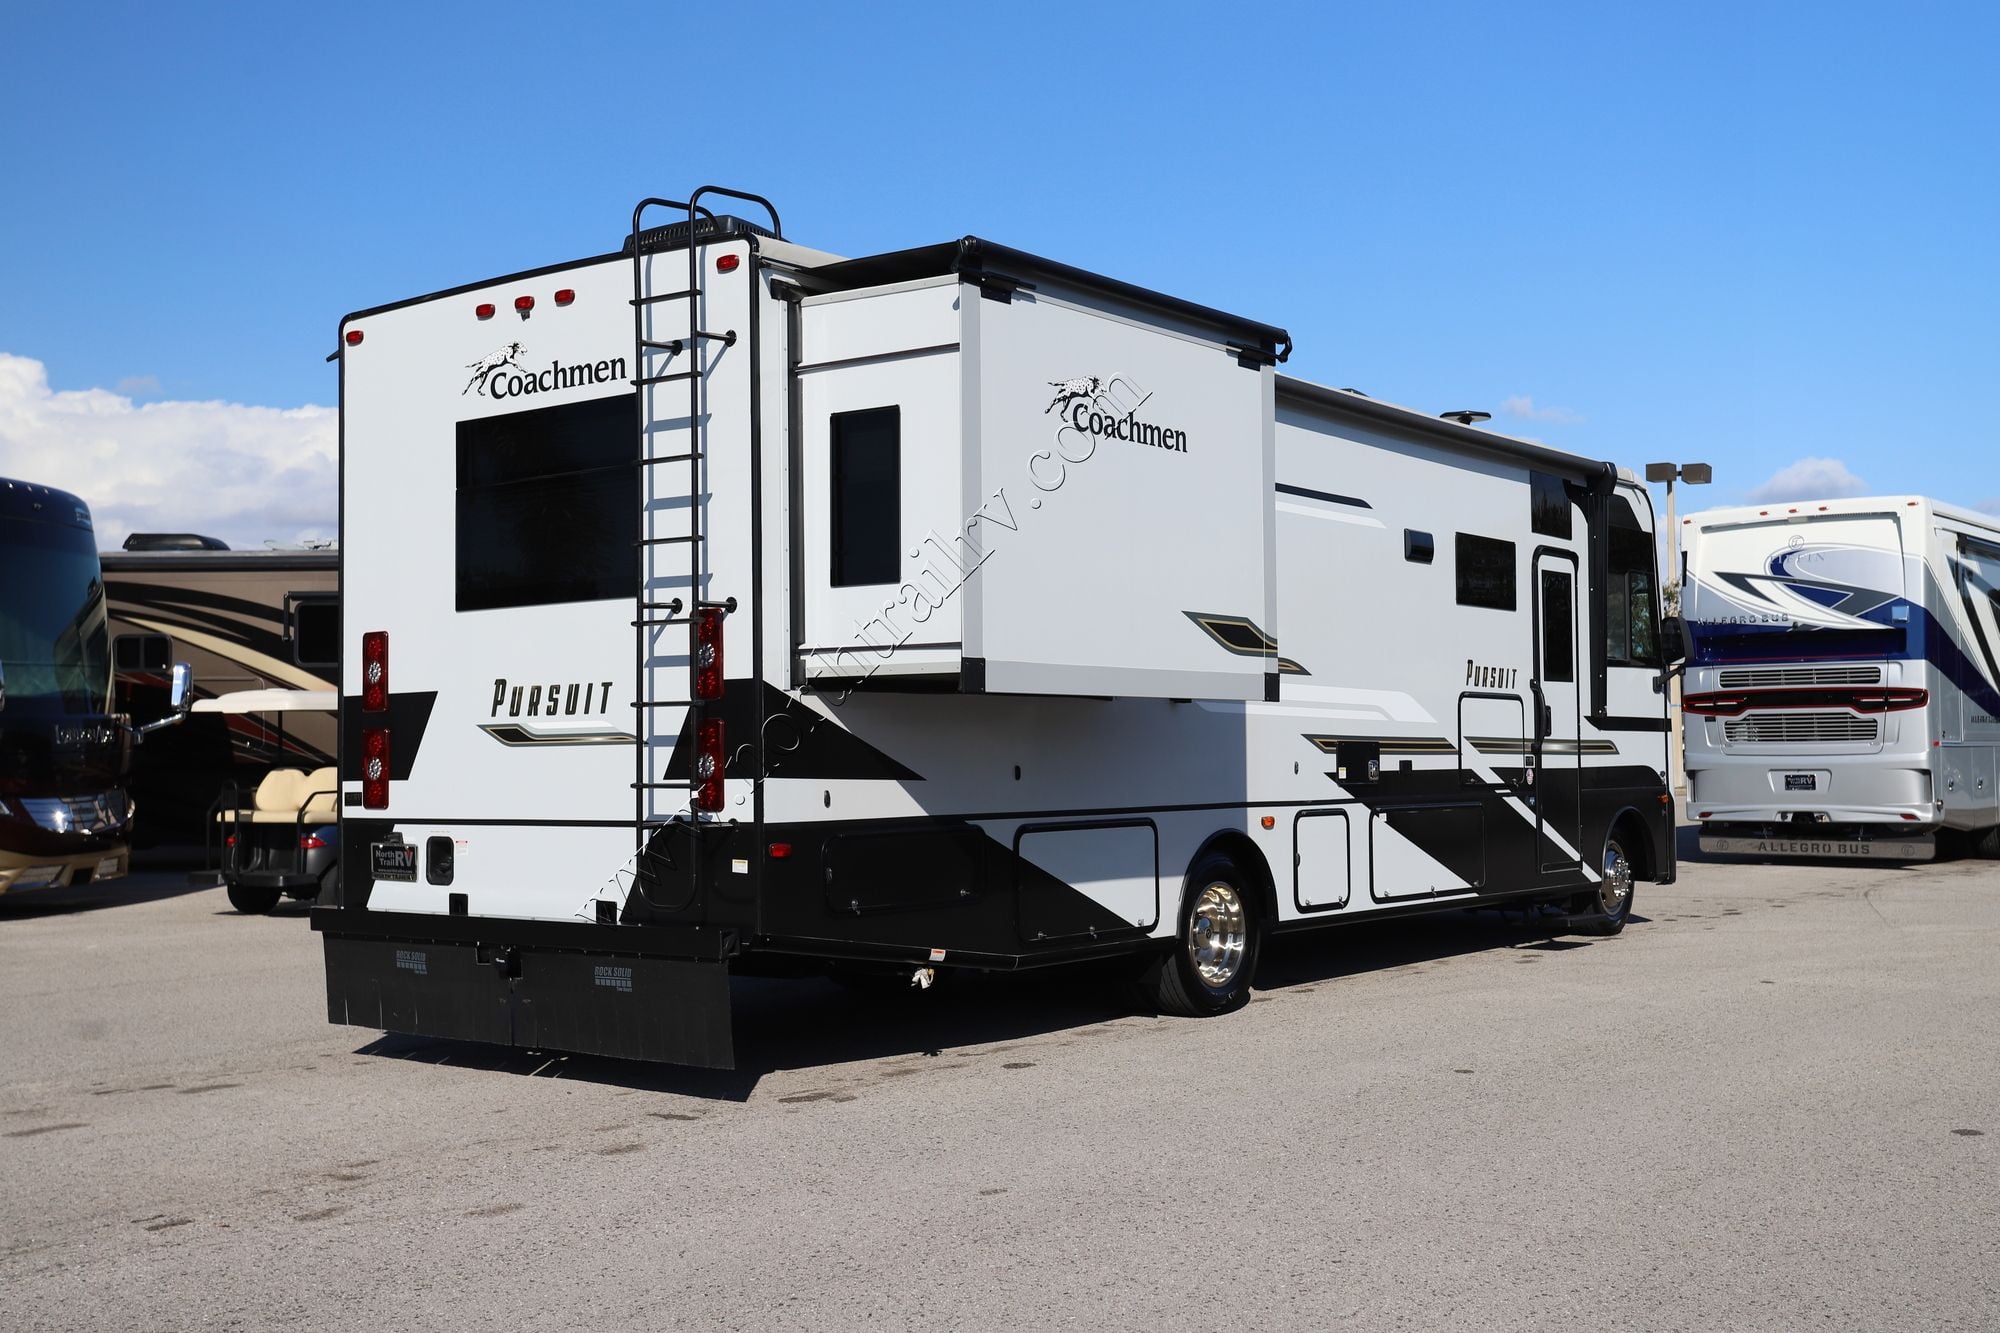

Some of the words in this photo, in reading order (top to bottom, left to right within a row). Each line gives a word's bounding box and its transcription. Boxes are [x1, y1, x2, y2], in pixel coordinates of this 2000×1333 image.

[490, 357, 627, 400] Coachmen
[1073, 403, 1187, 453] Coachmen
[1761, 613, 1789, 623] BUS
[1465, 659, 1518, 690] PURSUIT
[491, 678, 613, 718] PURSUIT
[1800, 777, 1813, 785] RV
[375, 849, 394, 858] North
[1757, 841, 1831, 854] ALLEGRO
[1837, 843, 1870, 855] BUS
[379, 858, 395, 867] Trail
[395, 850, 414, 867] RV
[594, 966, 612, 976] ROCK
[613, 967, 632, 978] SOLID
